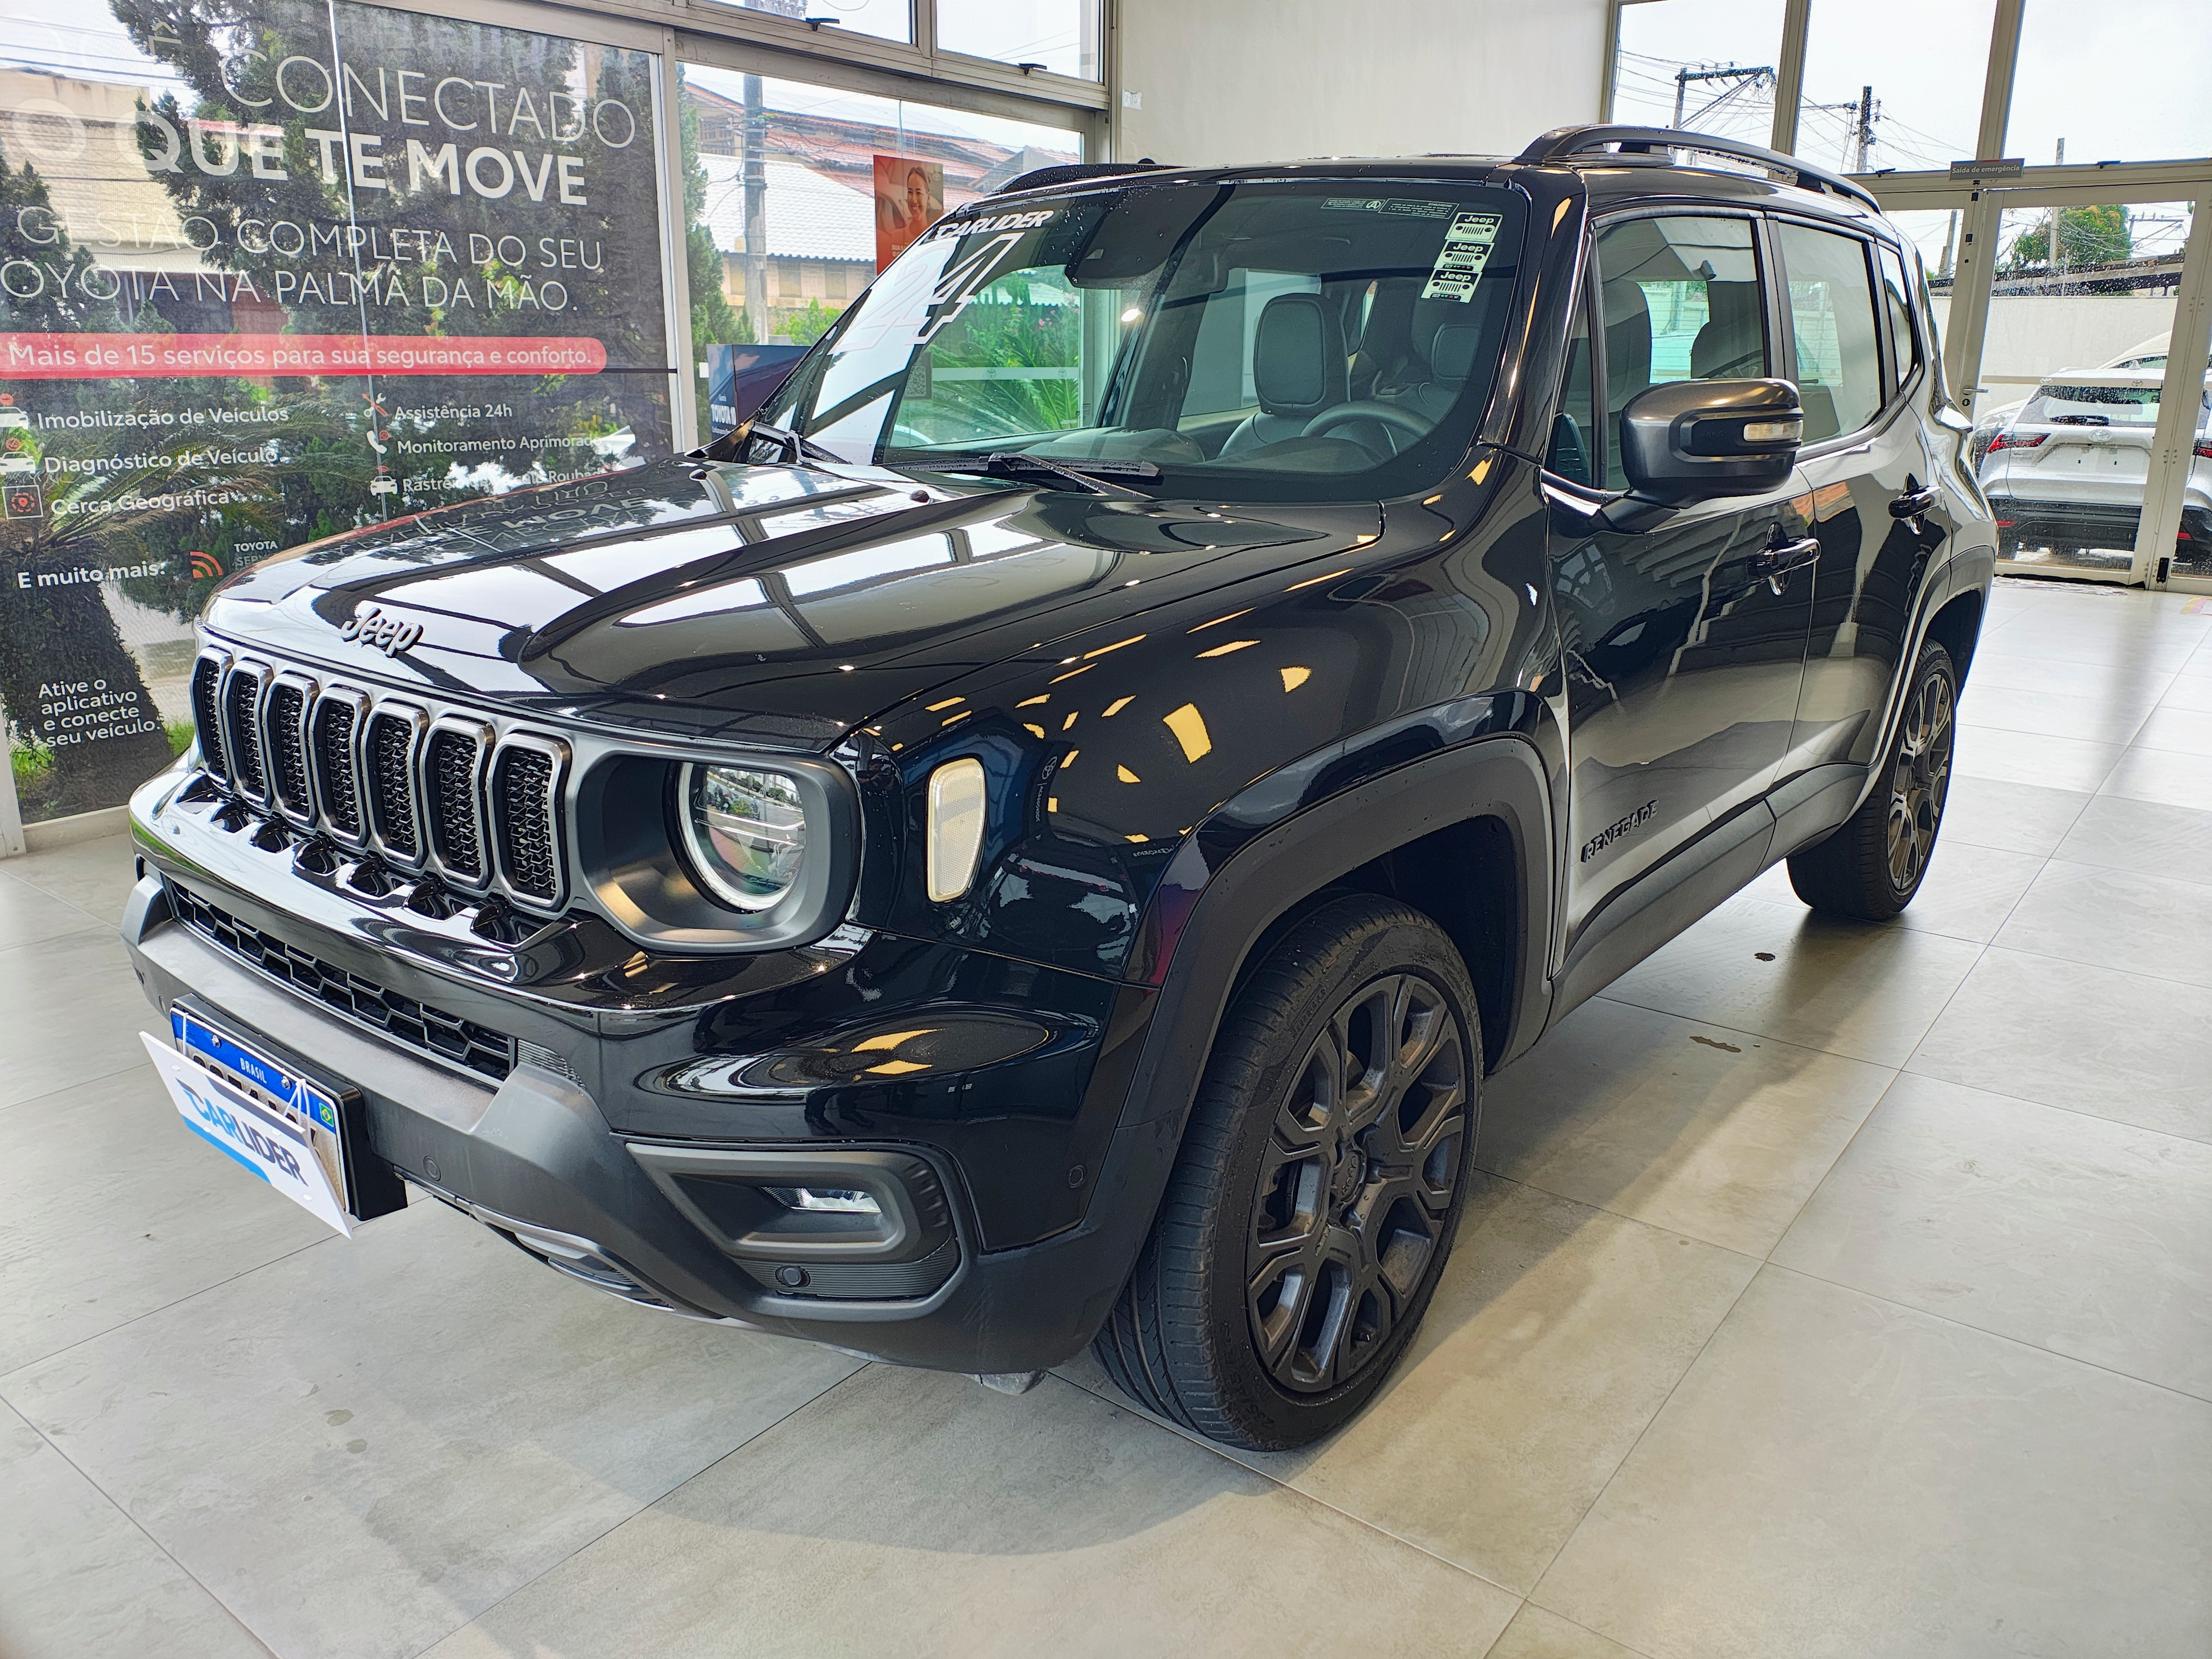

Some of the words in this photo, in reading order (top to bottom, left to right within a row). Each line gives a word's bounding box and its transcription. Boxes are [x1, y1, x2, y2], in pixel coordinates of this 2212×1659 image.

[221, 48, 635, 149] CONECTADO
[114, 110, 288, 181] QUE
[304, 128, 386, 188] TE
[406, 139, 587, 205] MOVE
[1981, 165, 2020, 173] emergência
[934, 210, 1054, 240] CARLIDER
[1464, 215, 1495, 225] Jeep
[17, 206, 219, 252] GESTÃO
[237, 219, 457, 264] COMPLETA
[469, 233, 527, 267] DO
[539, 237, 602, 271] SEU
[1453, 243, 1483, 253] Jeep
[195, 268, 261, 303] NA
[275, 269, 410, 307] PALMA
[422, 276, 475, 309] DA
[487, 274, 578, 311] MÃO.
[1440, 272, 1472, 282] Jeep
[9, 344, 76, 367] Mais
[84, 345, 119, 366] de
[127, 345, 156, 366] 15
[164, 346, 265, 369] serviços
[272, 349, 324, 368] para
[331, 349, 370, 364] sua
[376, 349, 484, 368] segurança
[490, 349, 502, 364] e
[508, 345, 592, 365] conforto.
[37, 409, 174, 430] Imobilização
[179, 408, 204, 425] de
[208, 406, 289, 423] Veículos
[395, 405, 481, 421] Assistência
[485, 403, 513, 419] 24h
[397, 437, 516, 455] Monitoramento
[520, 434, 602, 454] Aprimorado
[45, 451, 173, 474] Diagnóstico
[178, 450, 204, 468] de
[208, 447, 278, 465] Veículo
[51, 497, 112, 516] Cerca
[118, 490, 230, 515] Geográfica
[233, 541, 278, 552] TOYOTA
[18, 572, 32, 589] E
[37, 566, 103, 588] muito
[109, 561, 165, 582] mais.
[341, 607, 424, 658] Jeep
[38, 681, 89, 699] Ative
[93, 679, 107, 690] o
[41, 689, 137, 717] aplicativo
[43, 720, 56, 731] e
[59, 704, 139, 730] conecte
[46, 731, 82, 748] seu
[86, 716, 161, 742] veículo.
[1580, 799, 1659, 863] RENEGADE
[240, 1056, 267, 1084] BRASIL
[175, 1077, 309, 1188] CARLIDER
